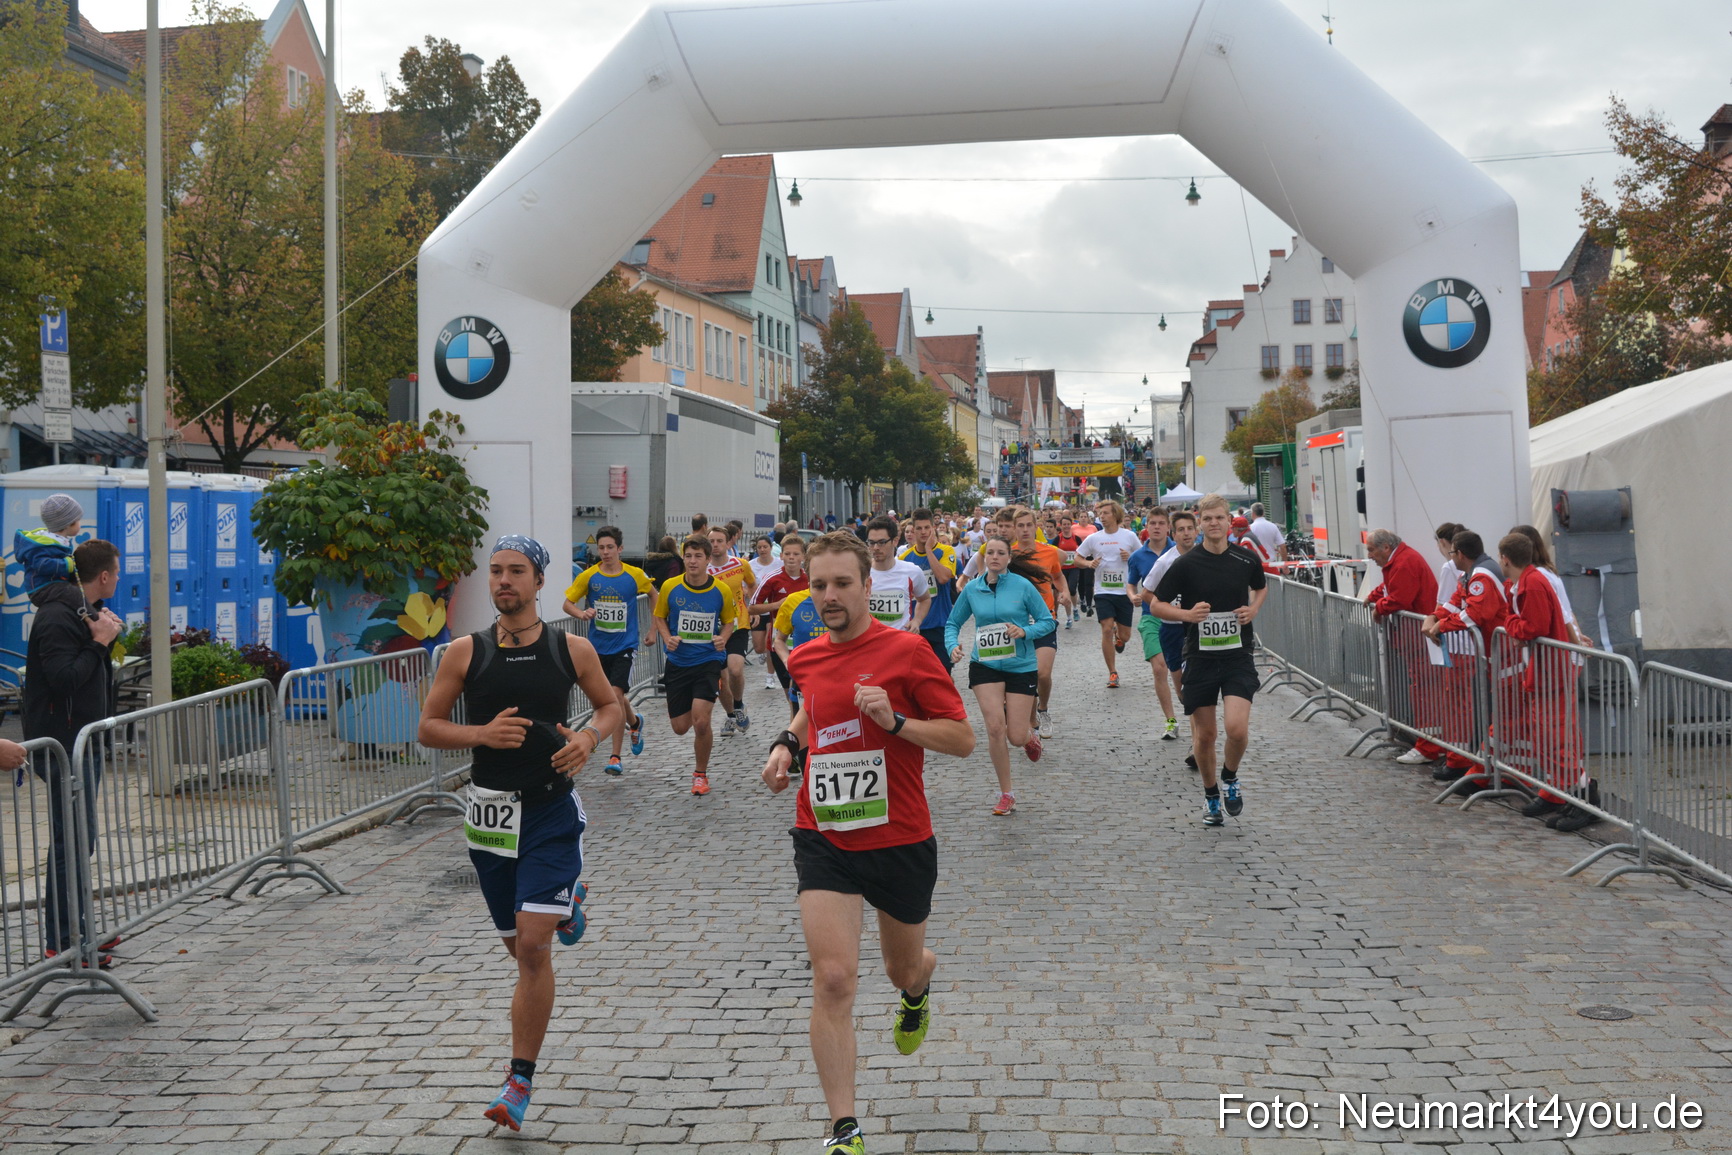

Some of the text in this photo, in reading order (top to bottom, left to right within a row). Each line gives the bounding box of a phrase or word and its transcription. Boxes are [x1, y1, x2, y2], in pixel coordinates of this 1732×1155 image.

[1409, 280, 1483, 311] BMW
[440, 318, 504, 346] BMW
[44, 366, 68, 375] Parkschein
[47, 377, 67, 386] werktags
[1062, 465, 1094, 474] START
[1103, 574, 1123, 582] 5164
[869, 599, 900, 612] 5211
[597, 608, 624, 621] 5518
[681, 618, 711, 632] 5093
[1203, 620, 1237, 636] 5045
[980, 631, 1011, 647] 5079
[506, 654, 536, 662] hummel
[826, 727, 848, 740] DEHN
[811, 759, 869, 770] PARTL Neumarkt
[815, 770, 879, 803] 5172
[828, 805, 866, 820] Manuel
[554, 894, 570, 903] adidas
